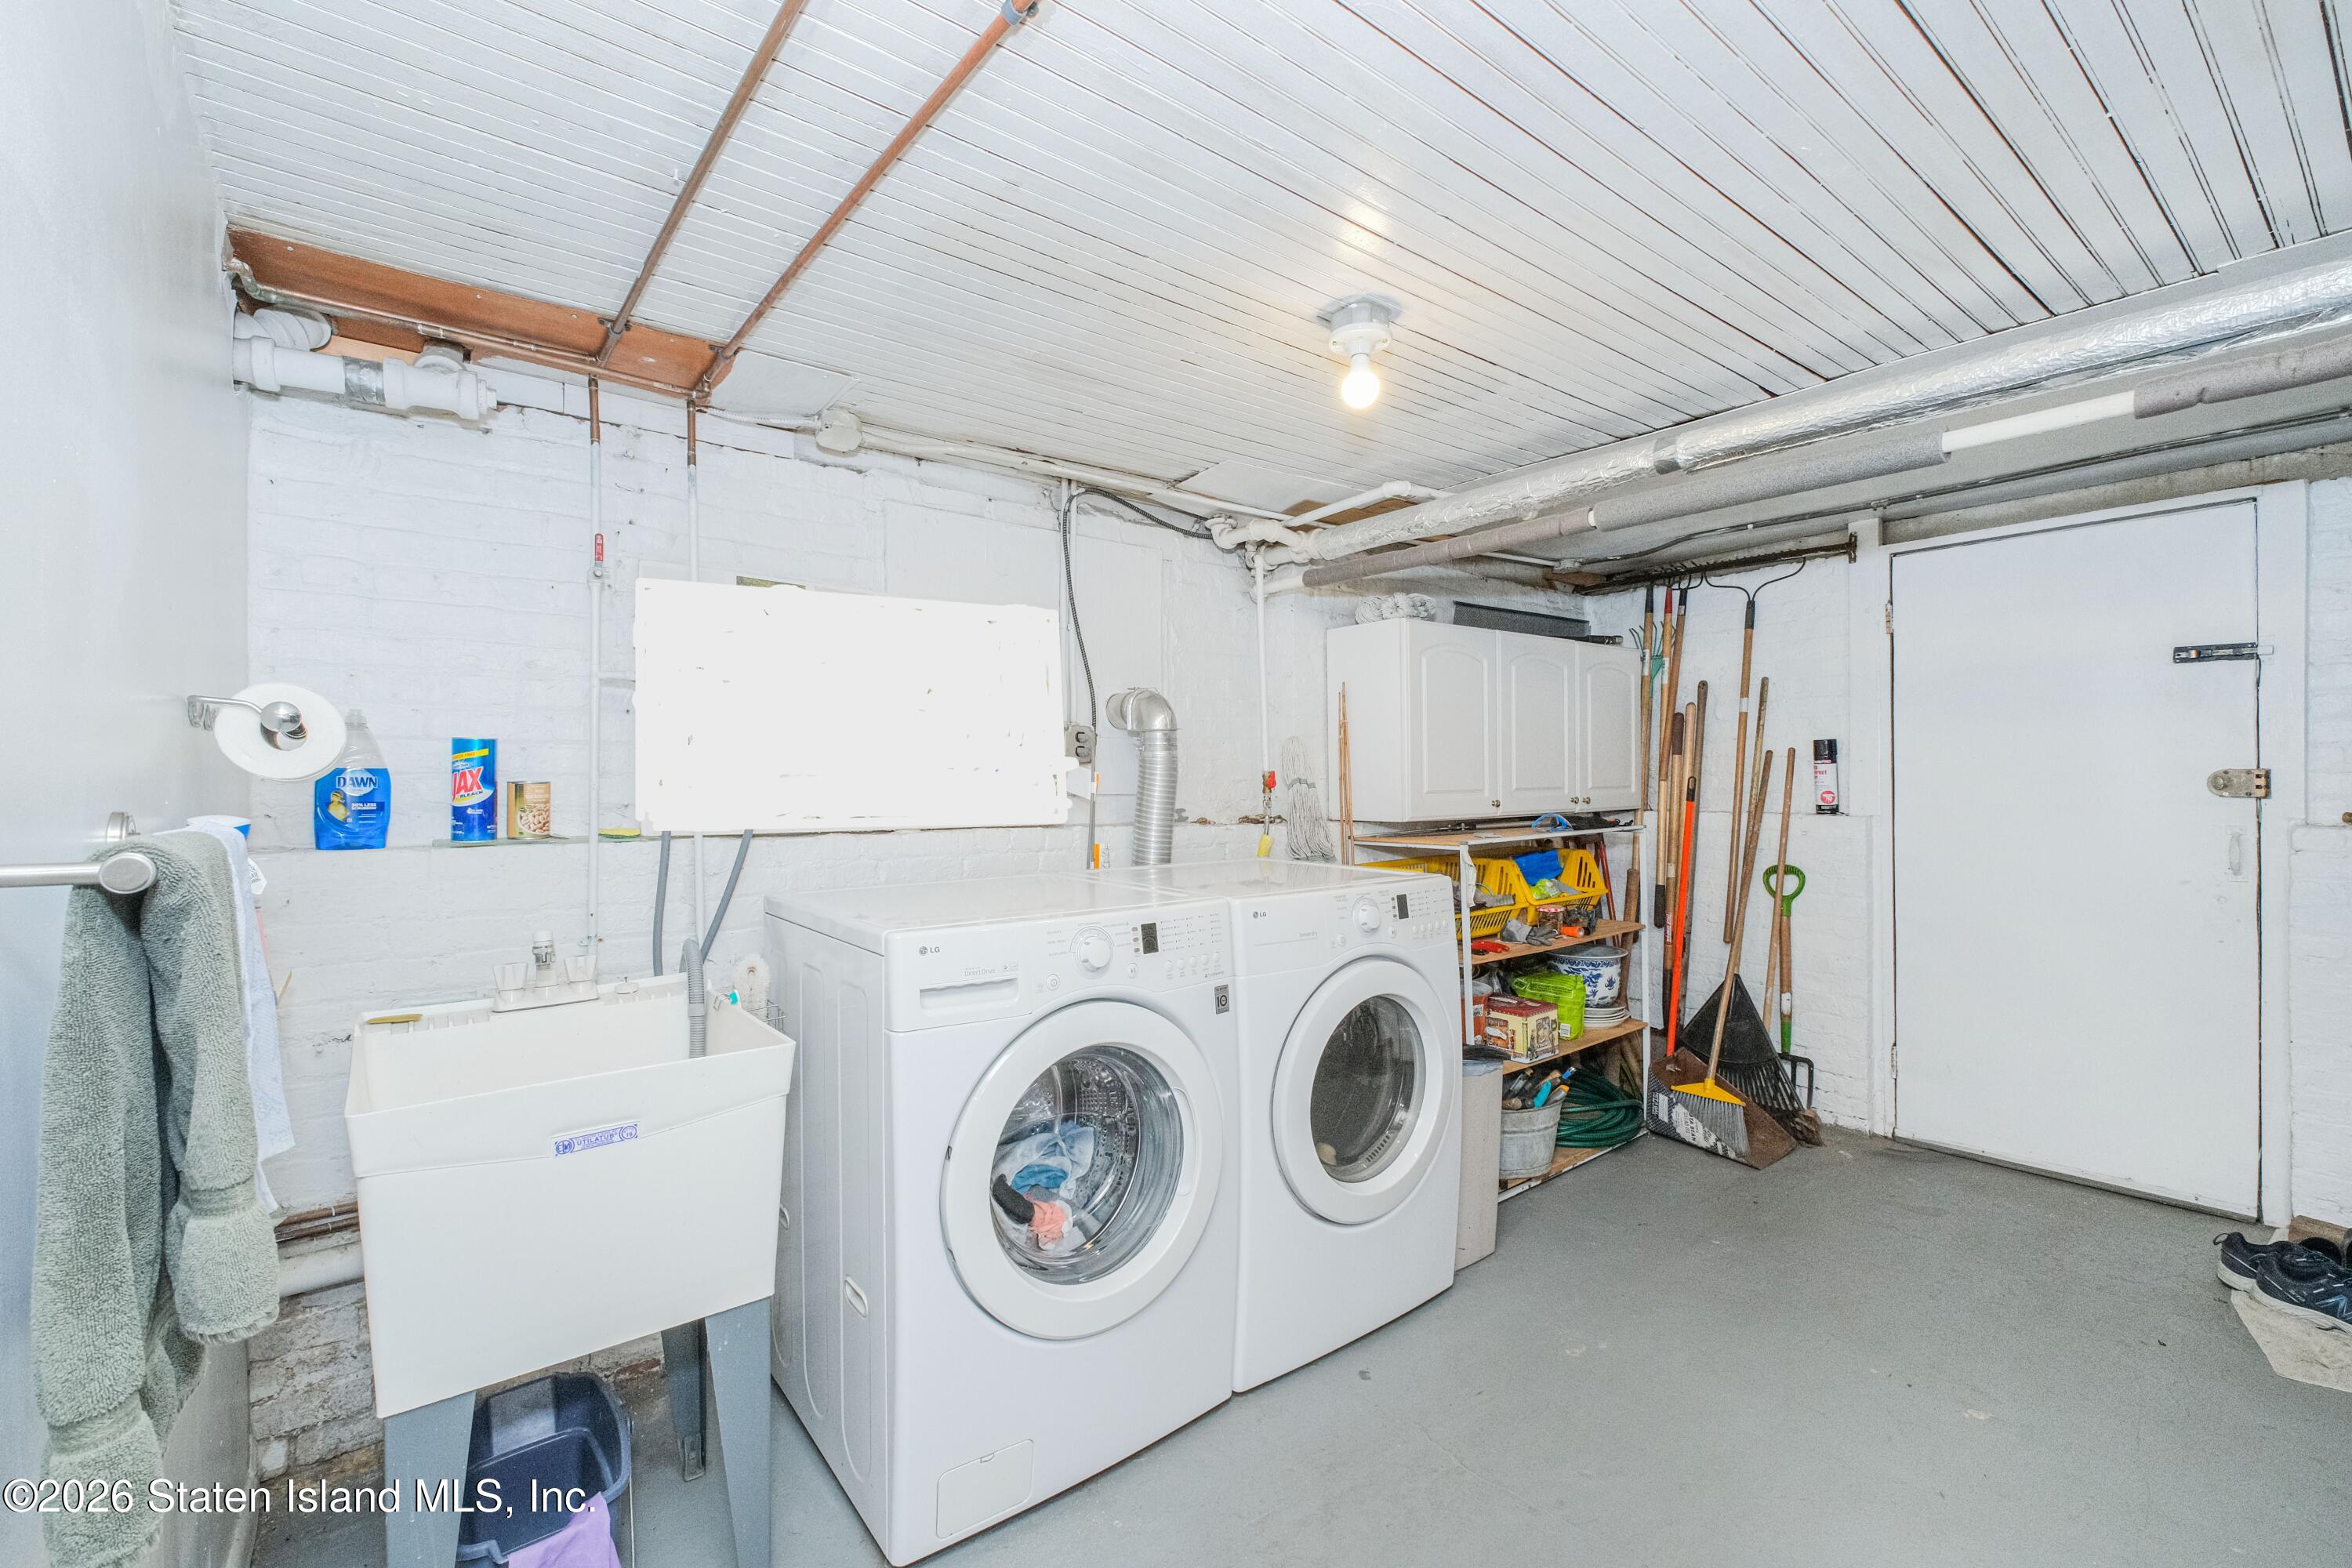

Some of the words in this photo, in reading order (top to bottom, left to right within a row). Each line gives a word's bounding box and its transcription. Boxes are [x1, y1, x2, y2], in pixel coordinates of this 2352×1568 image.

[337, 776, 377, 788] DAWN
[452, 767, 482, 802] JAX
[964, 968, 981, 977] Direct
